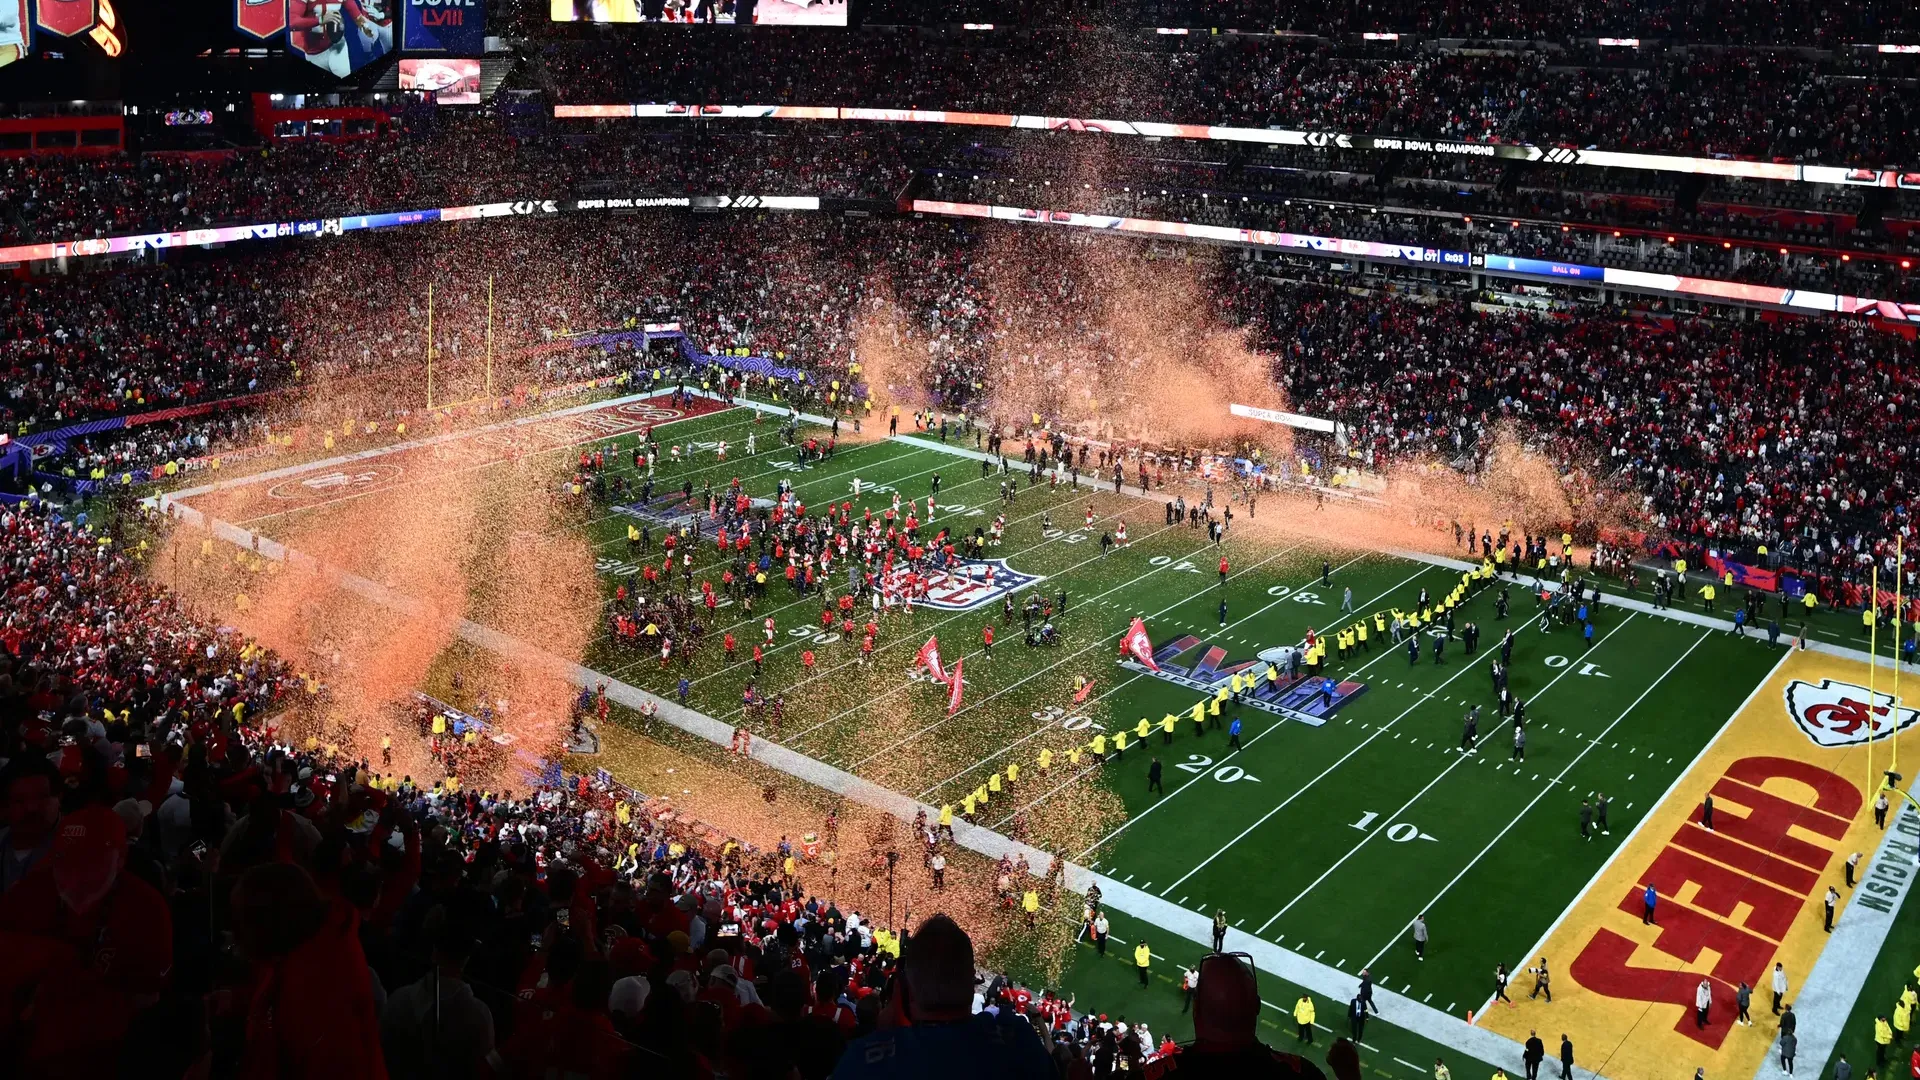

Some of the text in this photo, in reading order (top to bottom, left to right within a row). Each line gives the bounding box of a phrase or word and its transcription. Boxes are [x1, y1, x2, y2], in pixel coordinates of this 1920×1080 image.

[422, 8, 463, 26] LVIII
[1373, 139, 1495, 156] SUPER BOWL CHAMPIONS
[577, 198, 690, 209] SUPER BOWL CHAMPIONS
[413, 213, 423, 221] ON
[278, 226, 290, 236] OT
[298, 222, 318, 232] 0:03
[1424, 252, 1438, 262] OT
[1444, 253, 1464, 264] 0:03
[1552, 265, 1581, 276] BALL ON
[1149, 555, 1196, 573] 40
[1267, 586, 1319, 604] 30
[788, 624, 841, 645] 50
[1544, 655, 1602, 677] 10
[1140, 667, 1219, 694] SUPER
[1031, 705, 1093, 731] 30
[1175, 754, 1246, 783] 20
[1348, 811, 1419, 842] 10
[1857, 839, 1919, 914] RACISM
[1570, 756, 1864, 1051] CHIEFS
